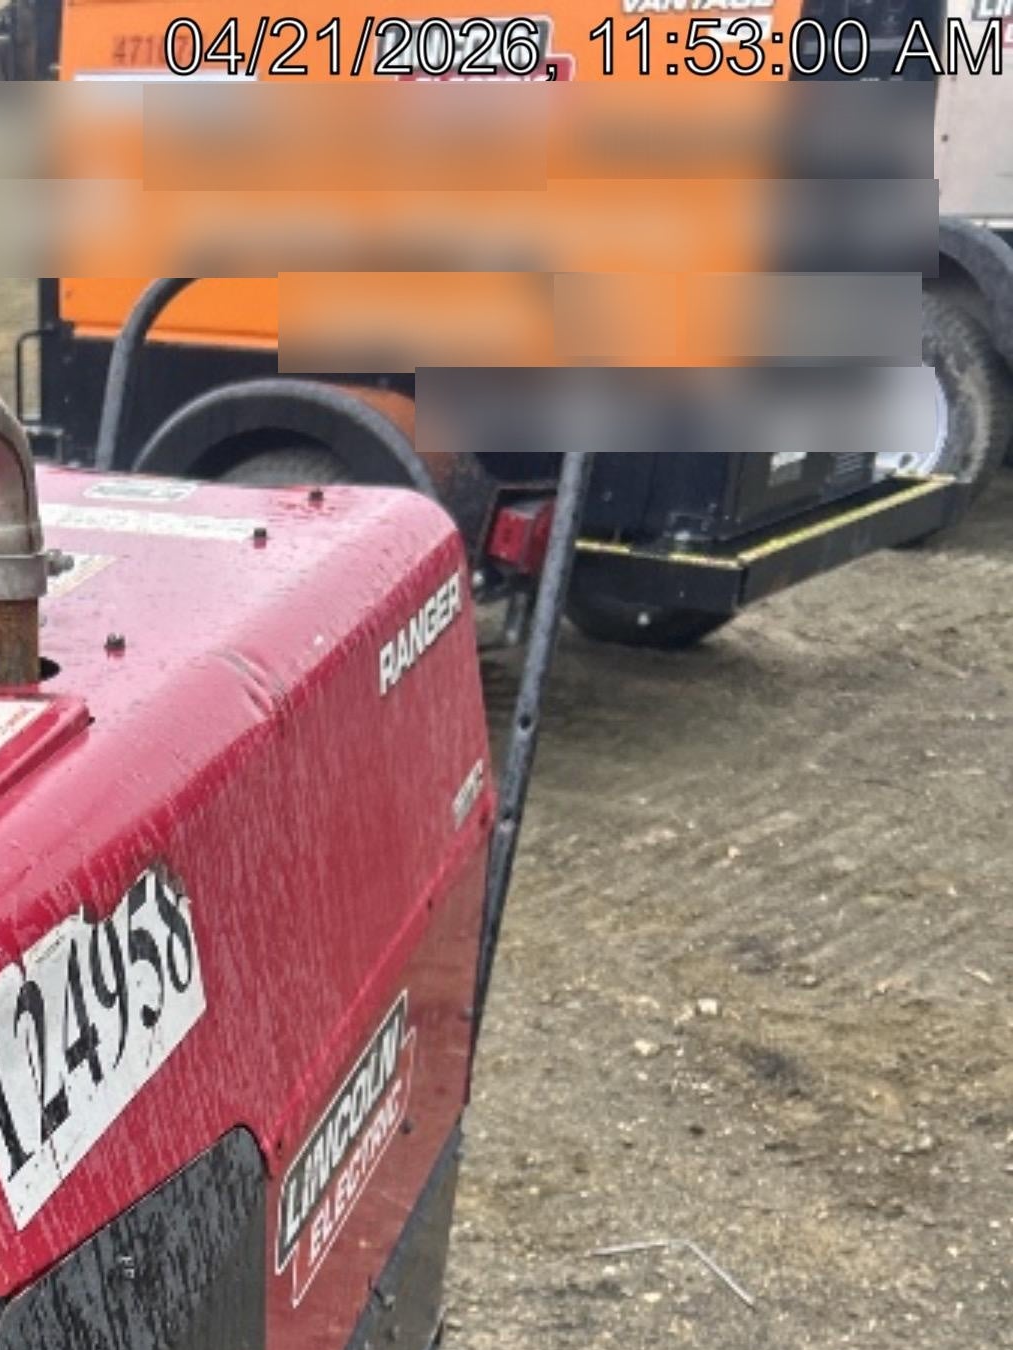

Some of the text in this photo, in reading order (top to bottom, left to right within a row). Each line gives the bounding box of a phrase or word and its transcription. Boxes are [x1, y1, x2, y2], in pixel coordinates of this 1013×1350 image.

[379, 571, 463, 697] RANGER
[283, 1013, 402, 1249] LINCOLN
[308, 1078, 403, 1267] ELECTRIC
